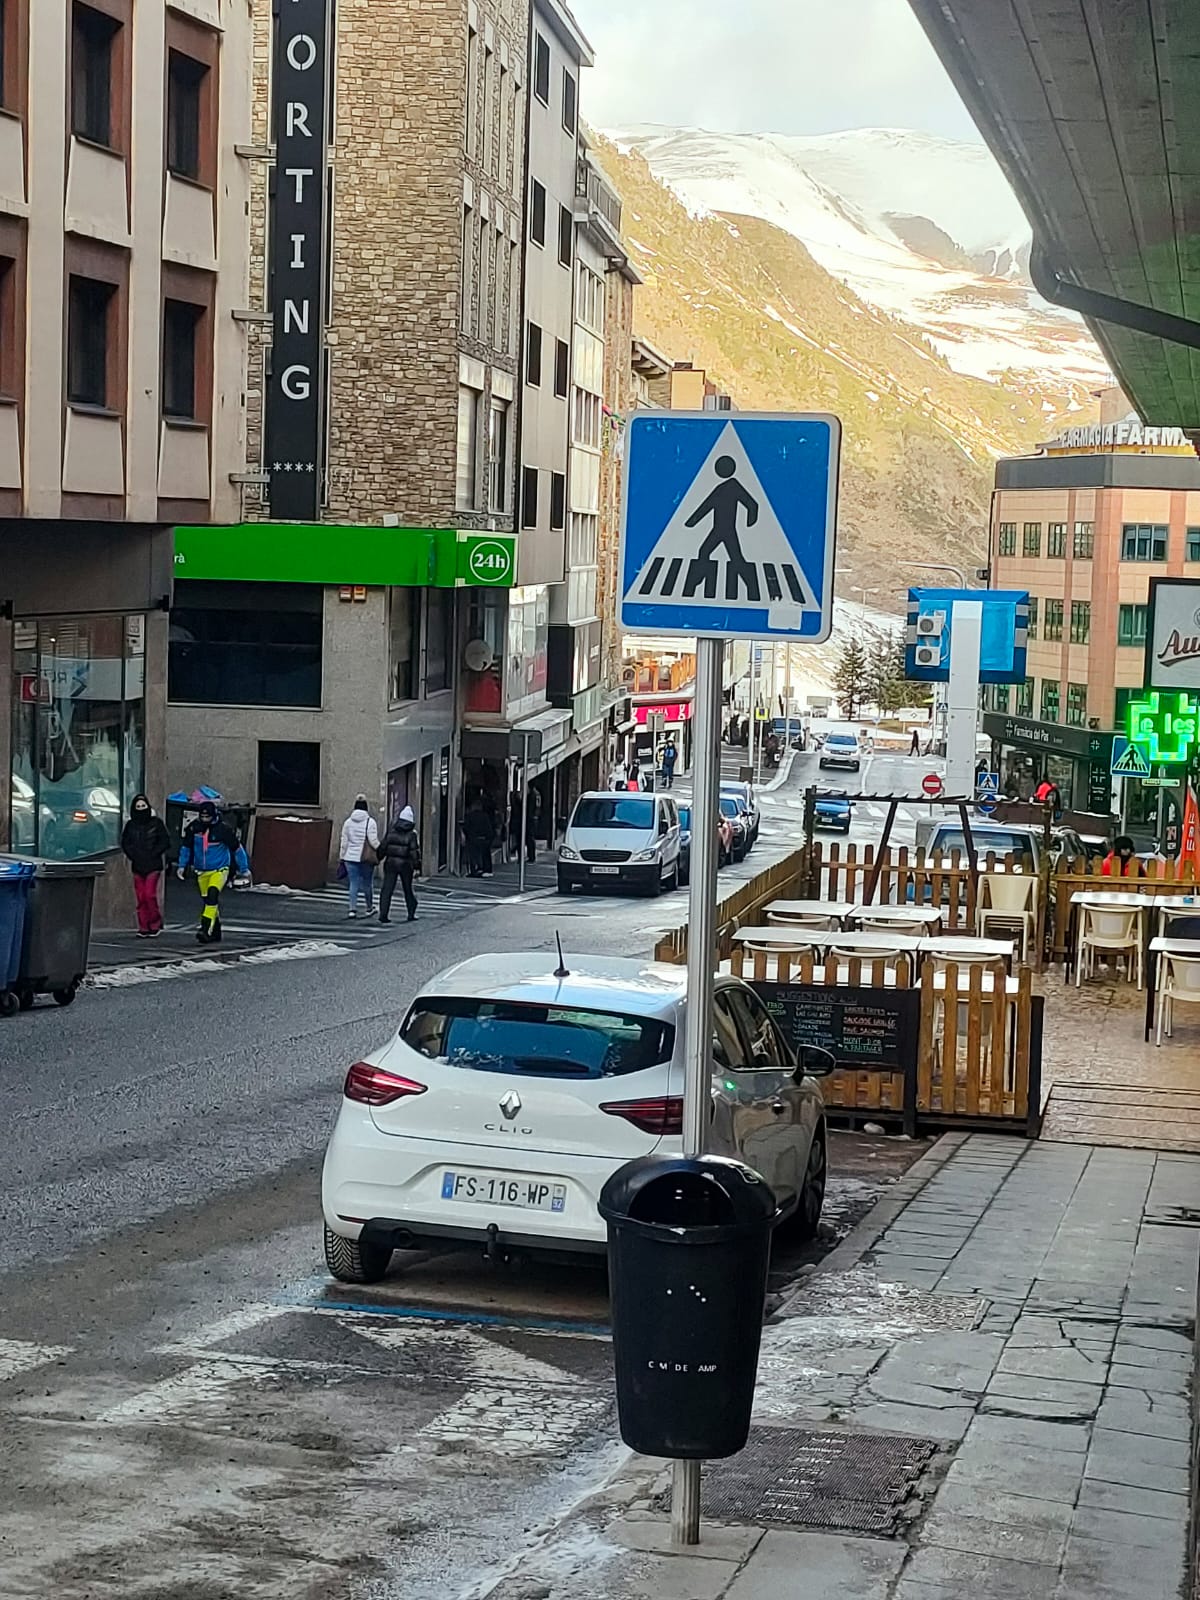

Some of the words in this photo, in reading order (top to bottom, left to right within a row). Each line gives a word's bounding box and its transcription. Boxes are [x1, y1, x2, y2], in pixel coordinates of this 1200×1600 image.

[281, 0, 317, 400] ORTING
[474, 553, 505, 568] 24h
[1157, 629, 1200, 656] Au
[484, 1123, 533, 1134] CLIO
[454, 1176, 549, 1204] FS-116-WP
